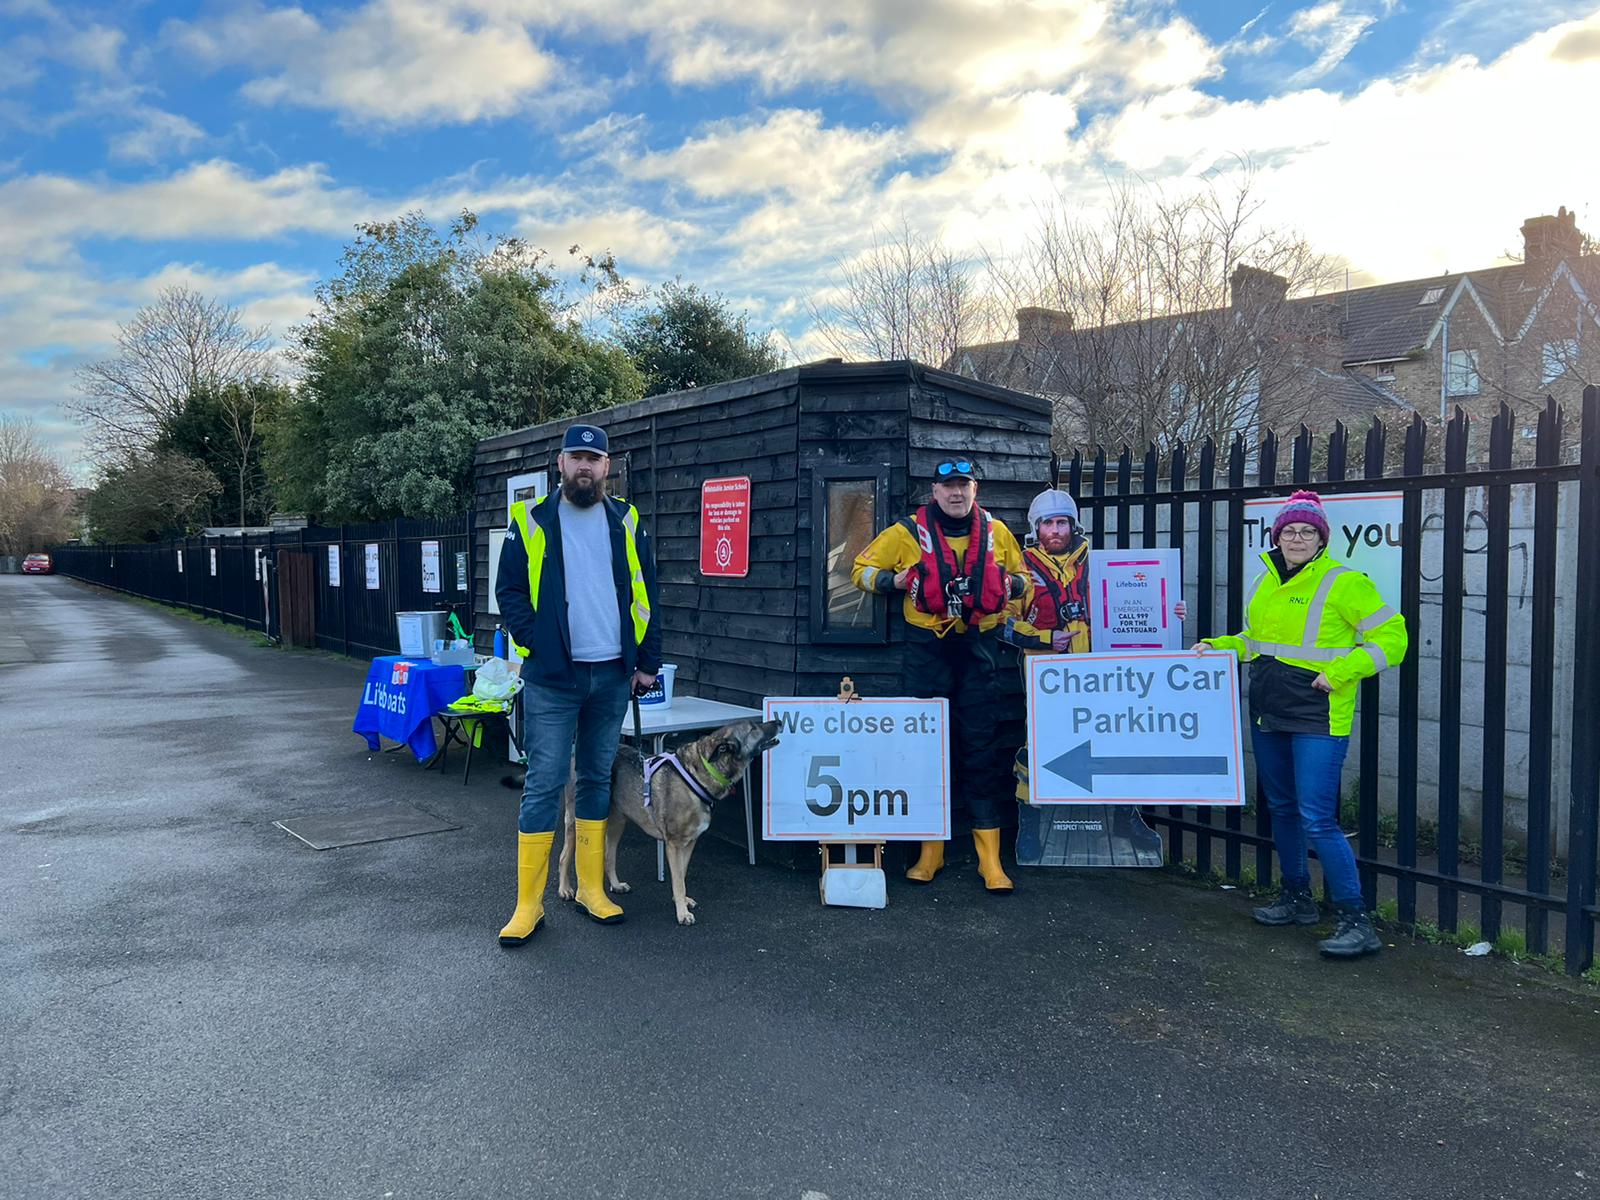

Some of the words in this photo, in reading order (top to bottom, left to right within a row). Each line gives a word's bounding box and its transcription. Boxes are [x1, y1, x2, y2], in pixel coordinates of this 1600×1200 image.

[1342, 523, 1403, 558] you
[1289, 597, 1310, 605] RNLI
[1039, 665, 1155, 699] Charity
[1167, 664, 1226, 691] Car
[773, 711, 815, 734] We
[824, 711, 895, 734] close
[903, 711, 936, 734] at:
[1072, 706, 1199, 740] Parking
[805, 755, 909, 825] 5pm
